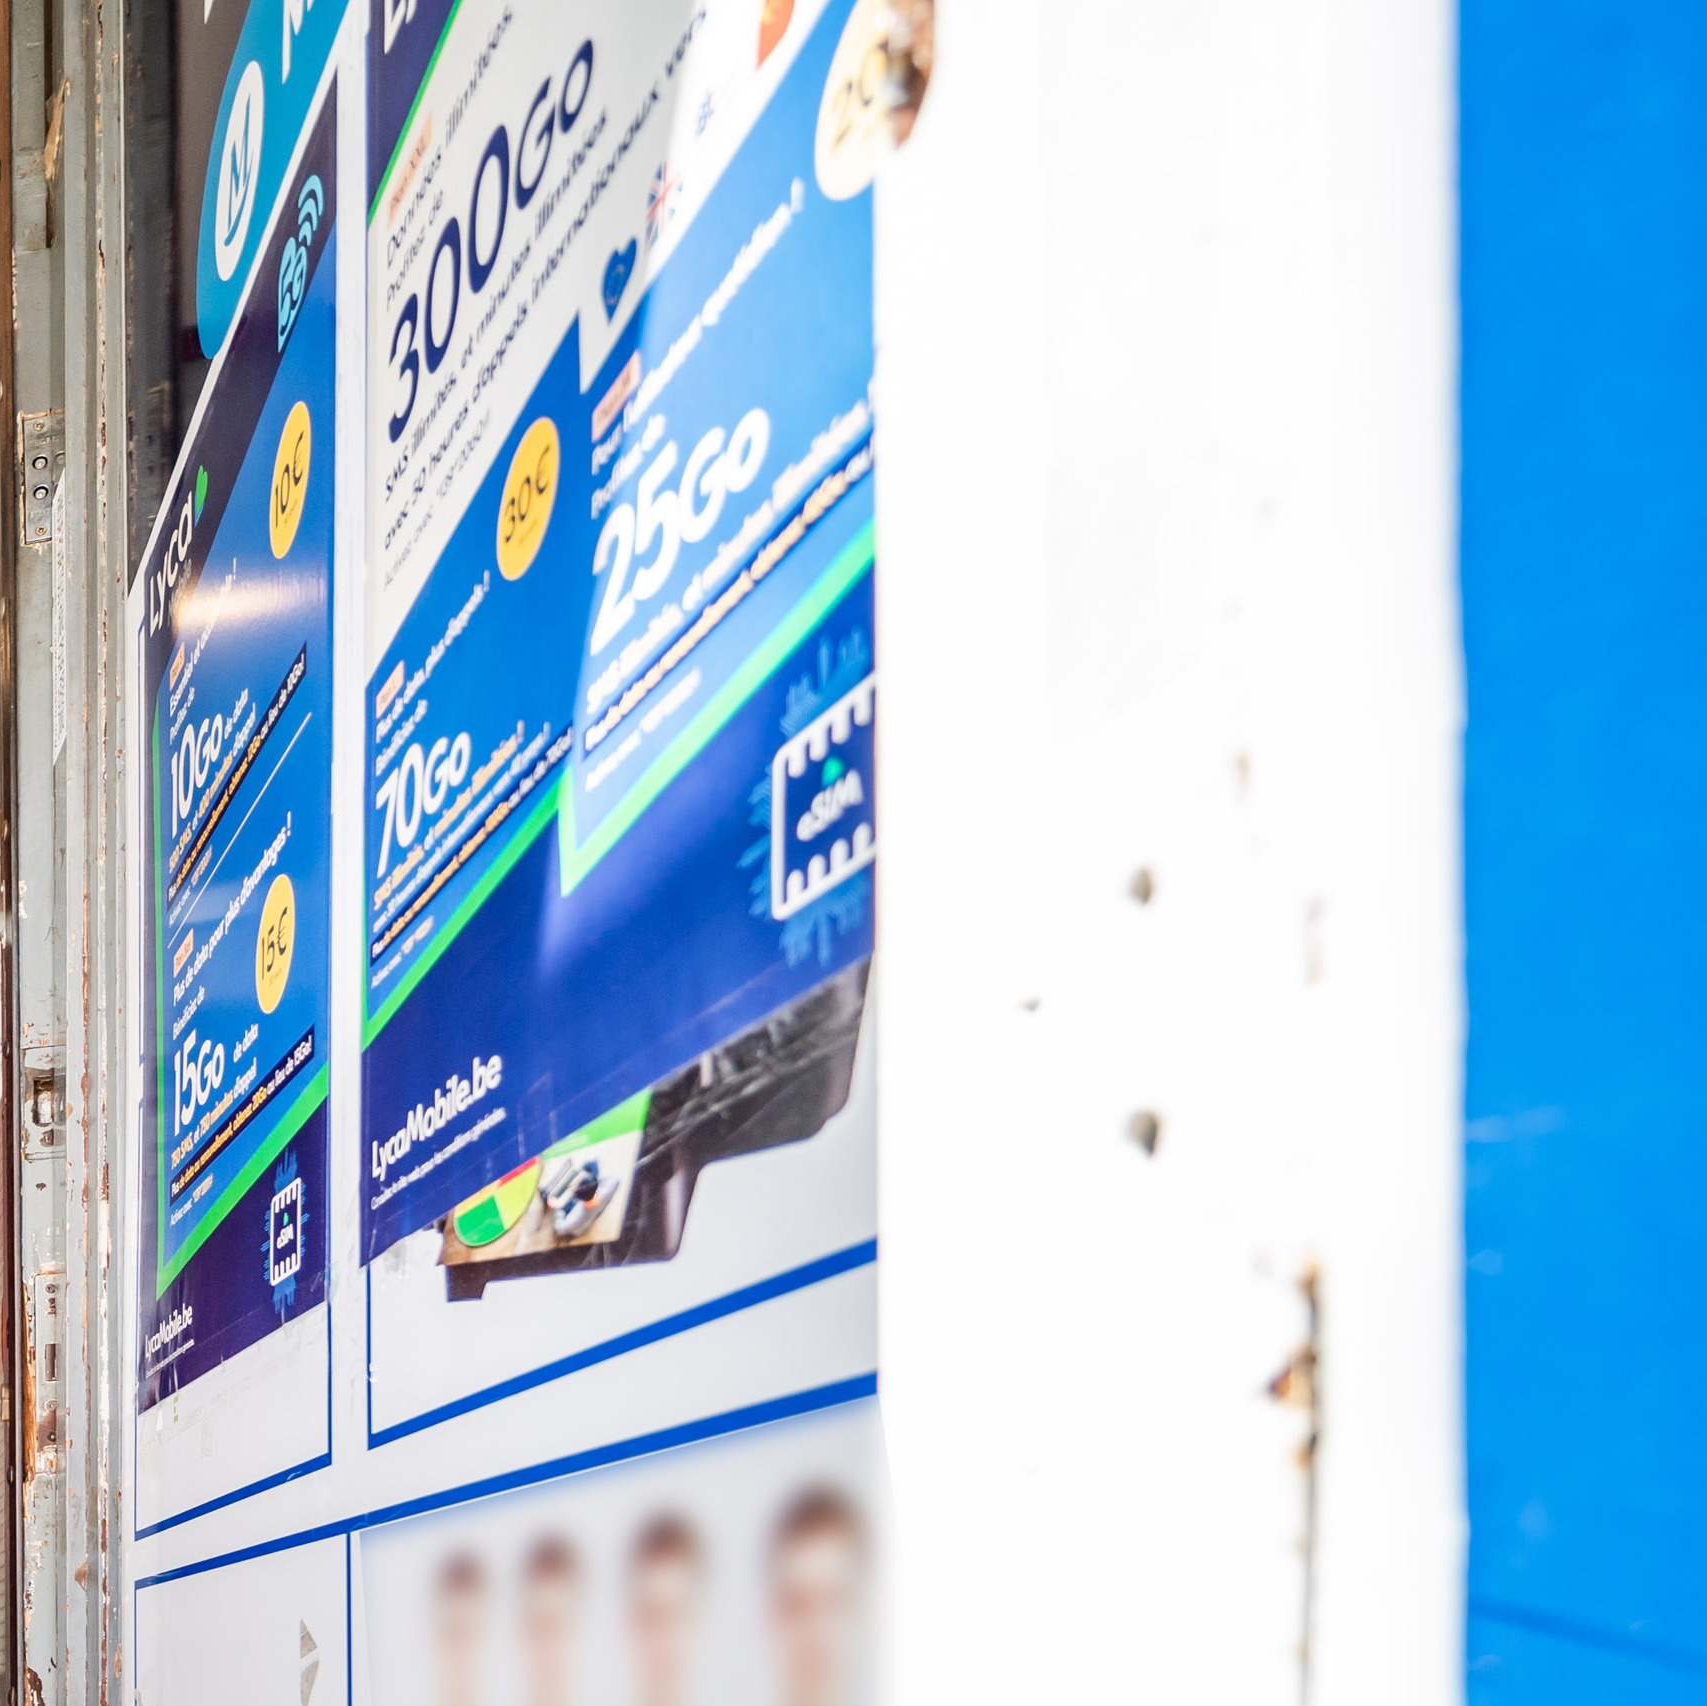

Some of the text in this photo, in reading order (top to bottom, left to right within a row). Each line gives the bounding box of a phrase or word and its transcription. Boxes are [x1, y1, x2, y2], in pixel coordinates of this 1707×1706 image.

[388, 3, 513, 270] Données illimitées
[388, 38, 594, 444] 300Go
[388, 190, 443, 312] Profitez de
[385, 500, 410, 551] avec
[428, 403, 469, 477] heures
[472, 298, 529, 404] d'appels
[532, 79, 660, 304] internationaux
[385, 447, 408, 503] SMS
[461, 334, 473, 369] et
[476, 238, 531, 343] minutes
[590, 407, 771, 656] 25Go
[171, 713, 223, 839] 10Go
[375, 732, 471, 879] 70Go
[262, 906, 288, 980] 15€
[174, 1029, 225, 1137] 15Go
[371, 1054, 503, 1182] LycaMobile.be
[145, 1303, 193, 1362] LycaMobile.be
